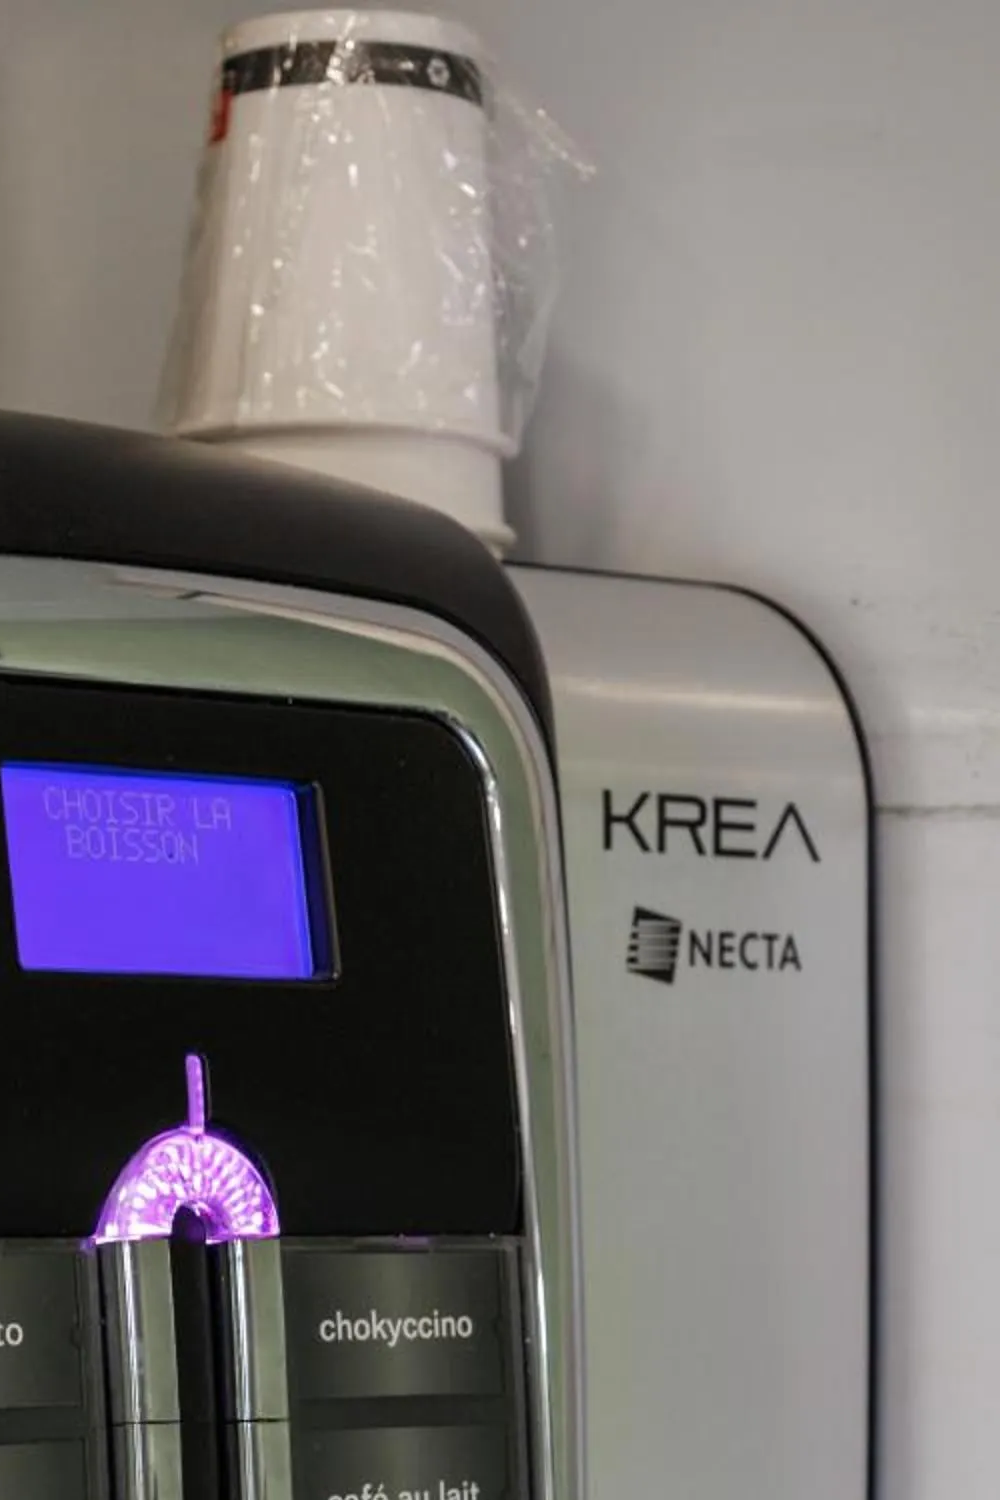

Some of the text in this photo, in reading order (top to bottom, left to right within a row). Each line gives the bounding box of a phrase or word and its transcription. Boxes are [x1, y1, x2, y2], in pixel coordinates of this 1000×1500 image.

[43, 787, 232, 831] CHOISIR LA
[65, 827, 199, 864] BOISSON
[688, 929, 803, 973] NECTA
[318, 1308, 474, 1346] chokyccino
